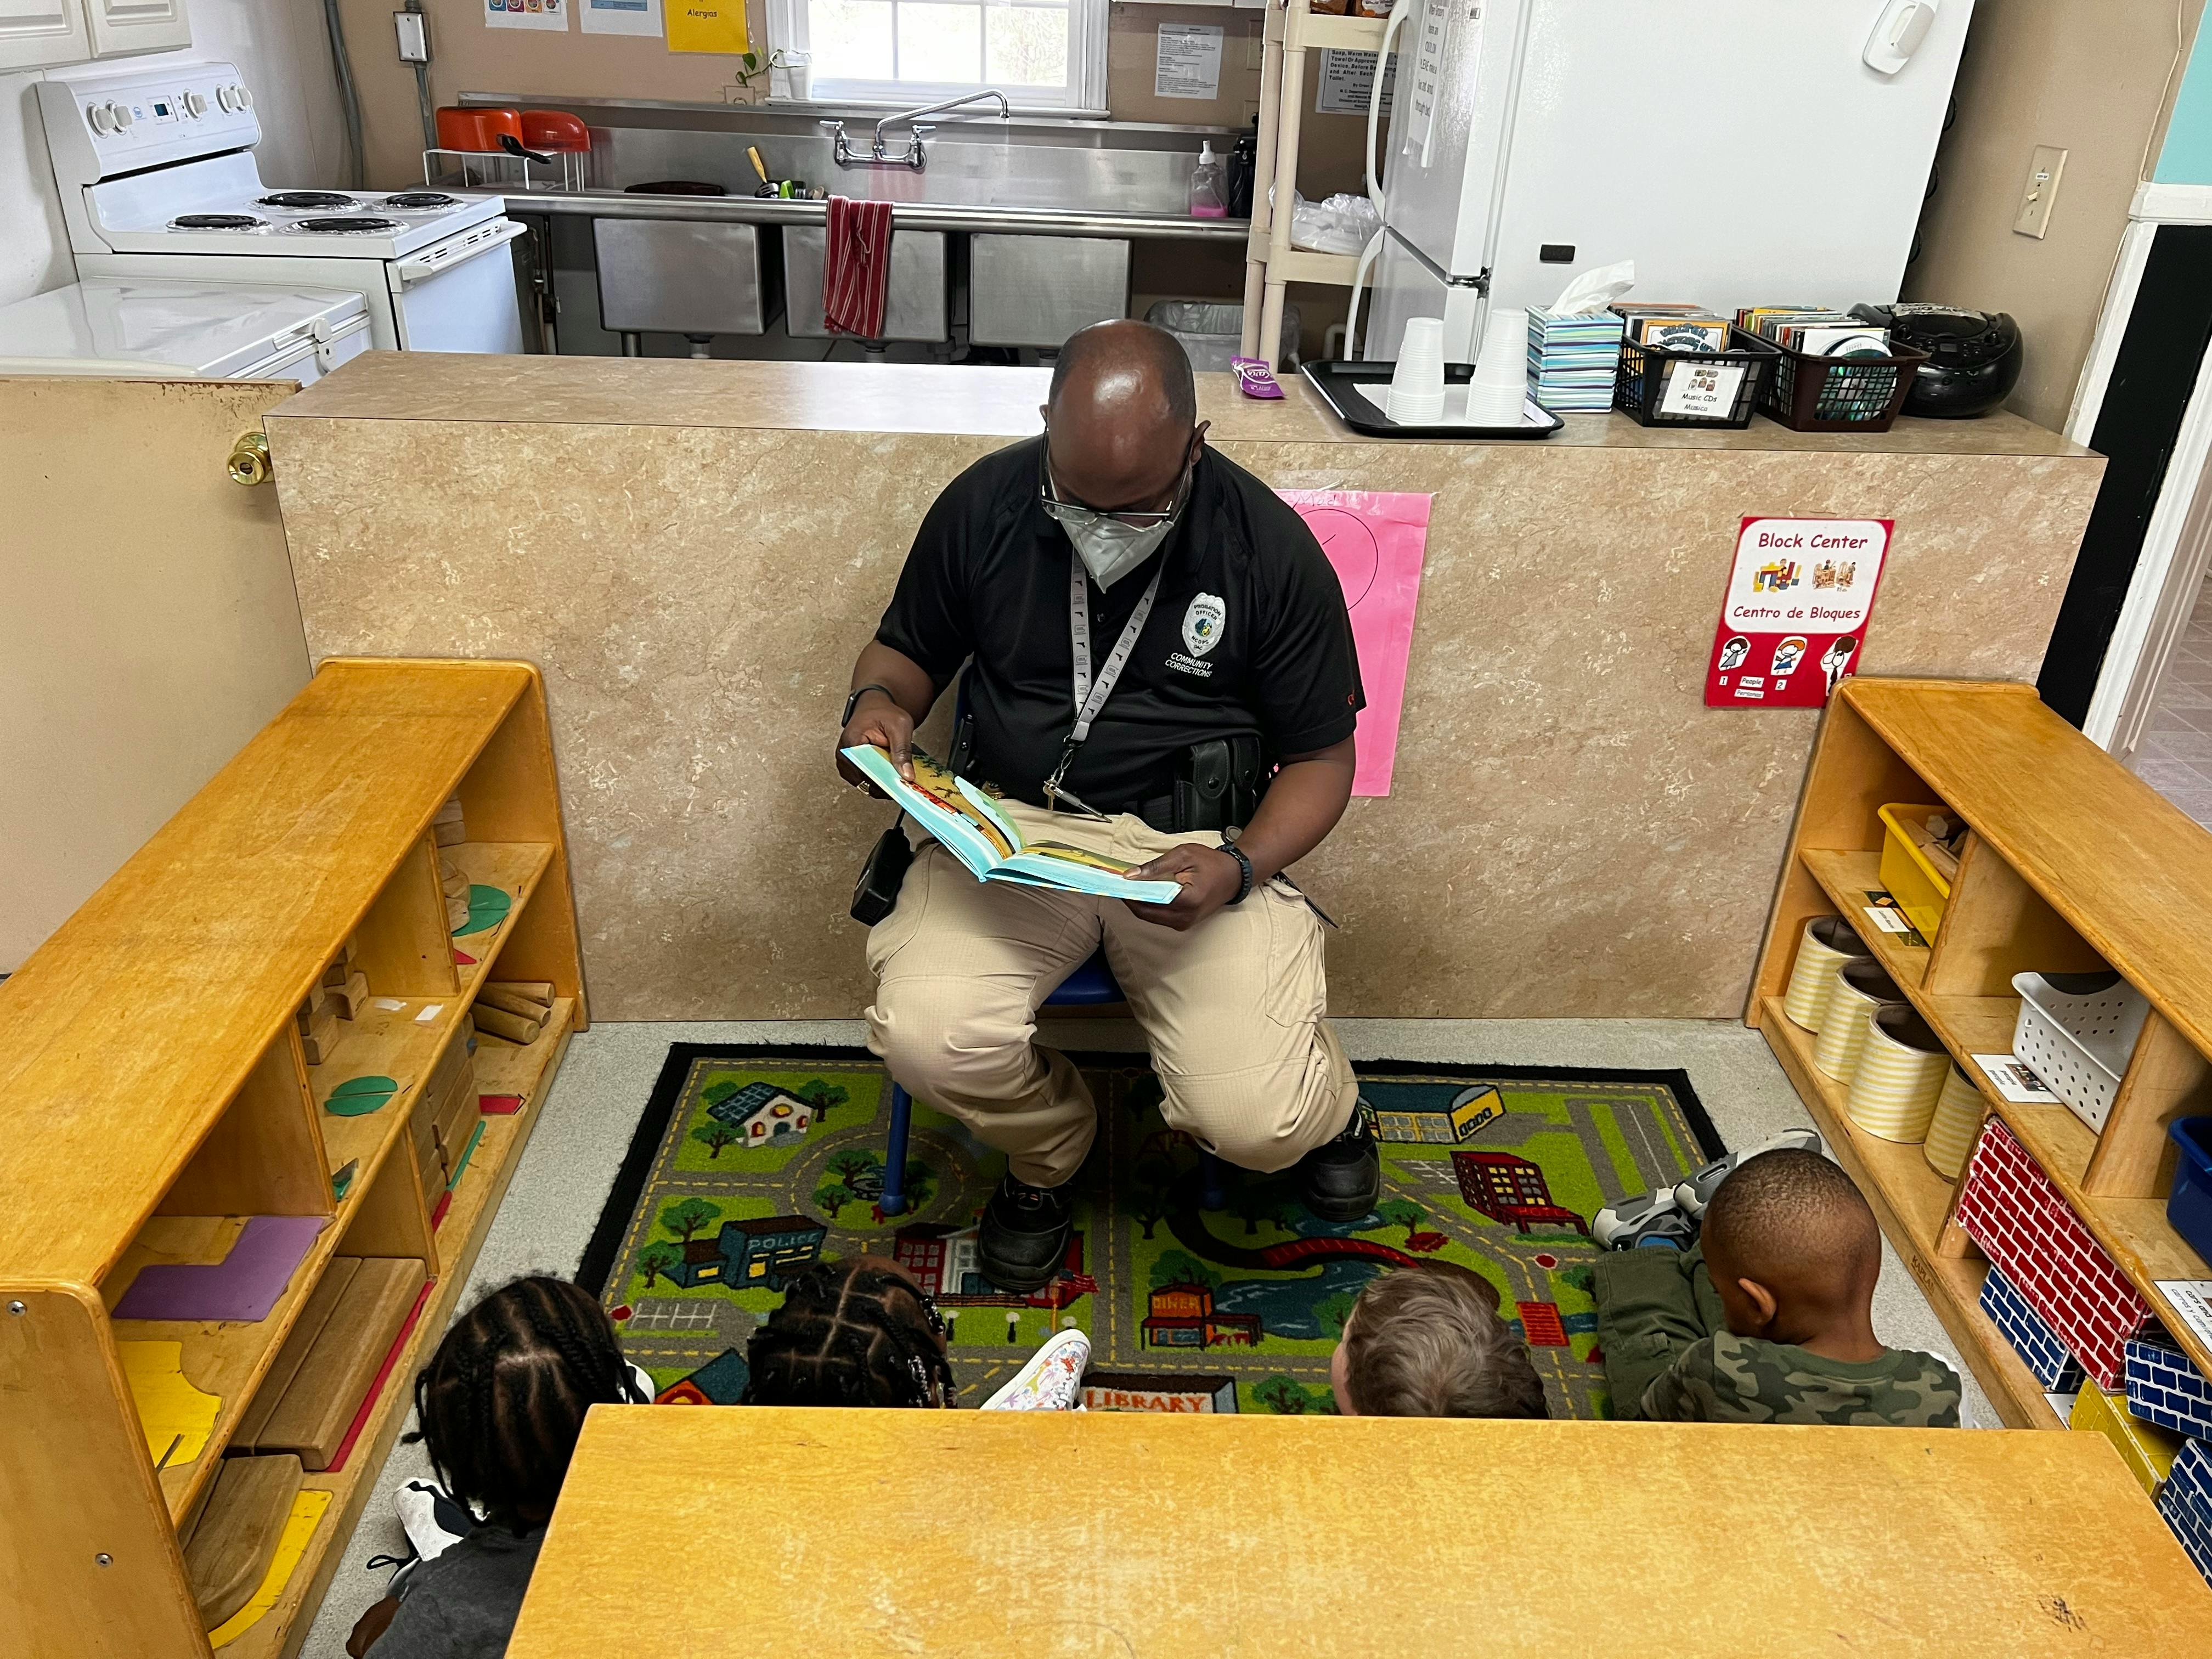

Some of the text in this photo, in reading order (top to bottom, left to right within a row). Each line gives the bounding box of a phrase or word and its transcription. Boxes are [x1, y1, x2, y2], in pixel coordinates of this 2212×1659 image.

[1681, 392, 1701, 401] Music
[1758, 532, 1869, 549] Block Center
[1193, 604, 1221, 617] PROBATION
[1195, 610, 1218, 621] OFFICER
[1734, 606, 1861, 622] Centro de Bloques
[1165, 659, 1212, 678] CORRECTIONS
[1170, 652, 1214, 670] COMMUNITY
[1741, 678, 1762, 686] People
[1736, 690, 1762, 698] Personas
[2185, 1290, 2202, 1305] cars
[1086, 1390, 1206, 1413] LIBRARY
